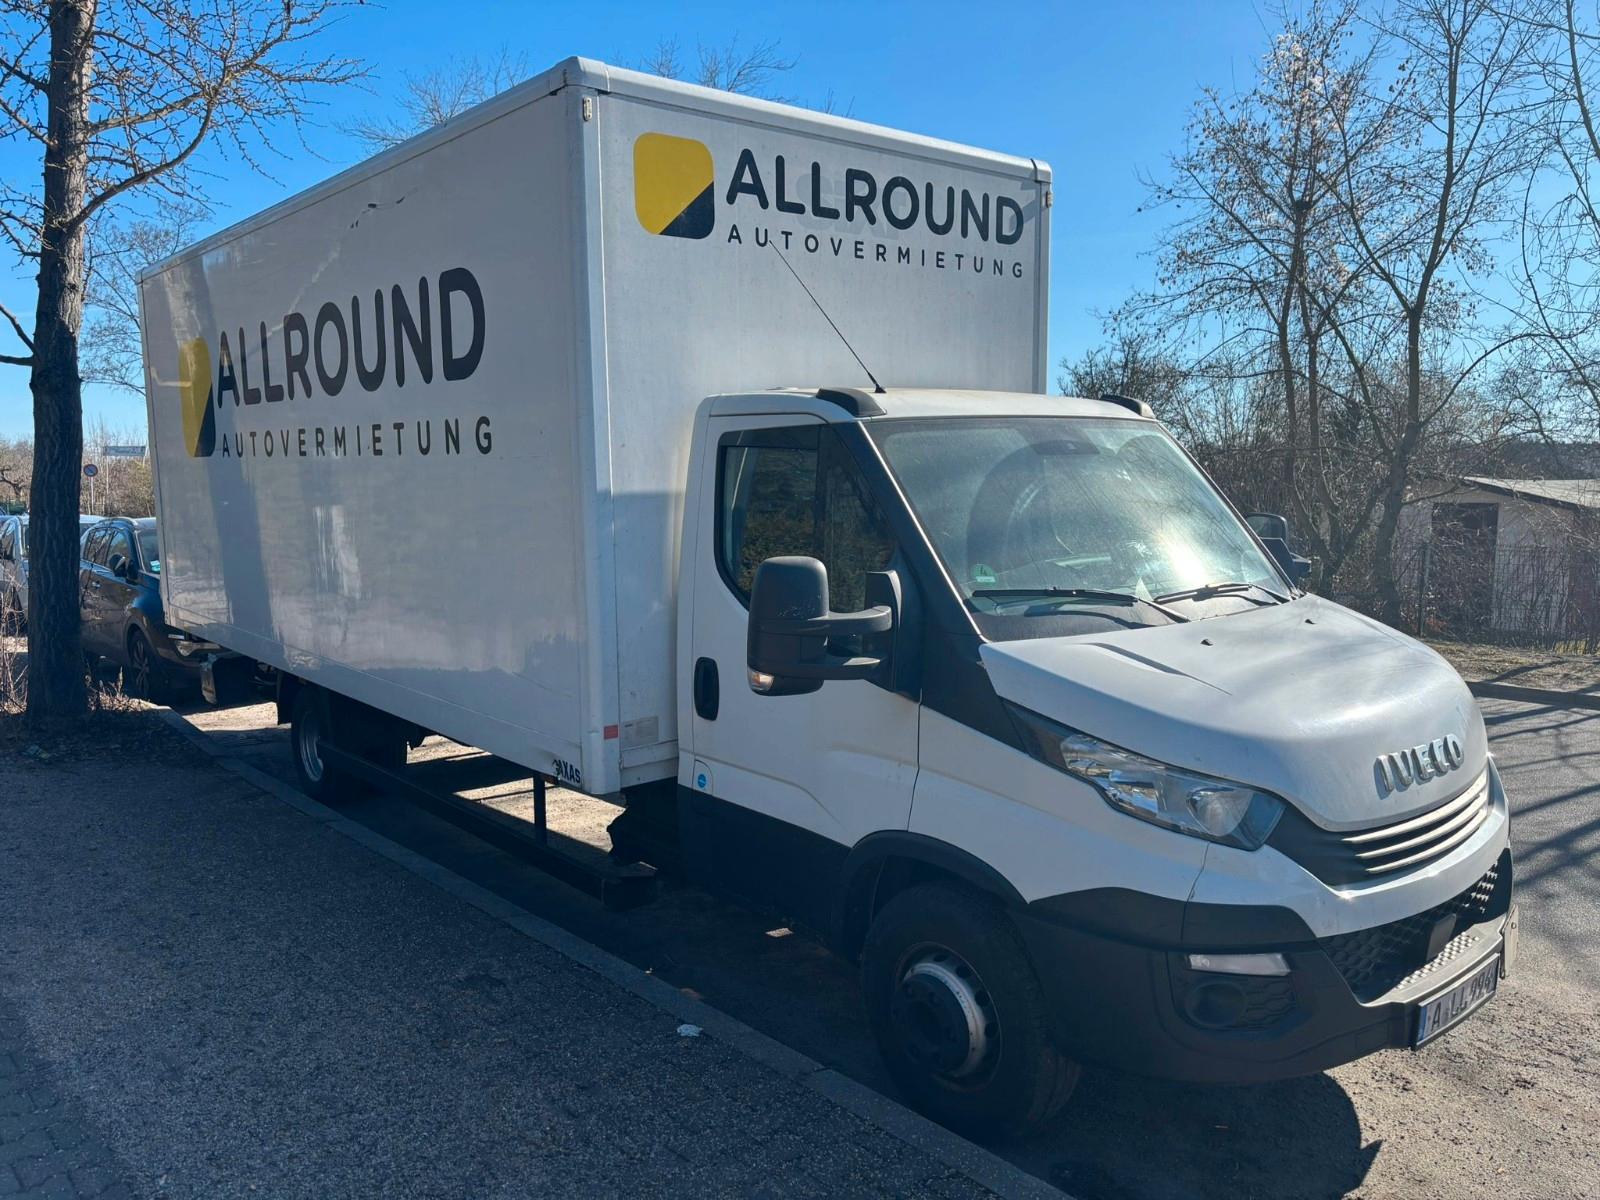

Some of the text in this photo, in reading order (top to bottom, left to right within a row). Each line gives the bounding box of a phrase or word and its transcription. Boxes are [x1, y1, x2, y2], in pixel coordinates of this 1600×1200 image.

[726, 148, 1025, 245] ALLROUND
[727, 224, 1024, 279] AUTOVERMIETUNG
[217, 267, 486, 409] ALLROUND
[222, 416, 493, 458] AUTOVERMIETUNG
[1373, 733, 1464, 800] IVECO
[1431, 1002, 1442, 1031] A
